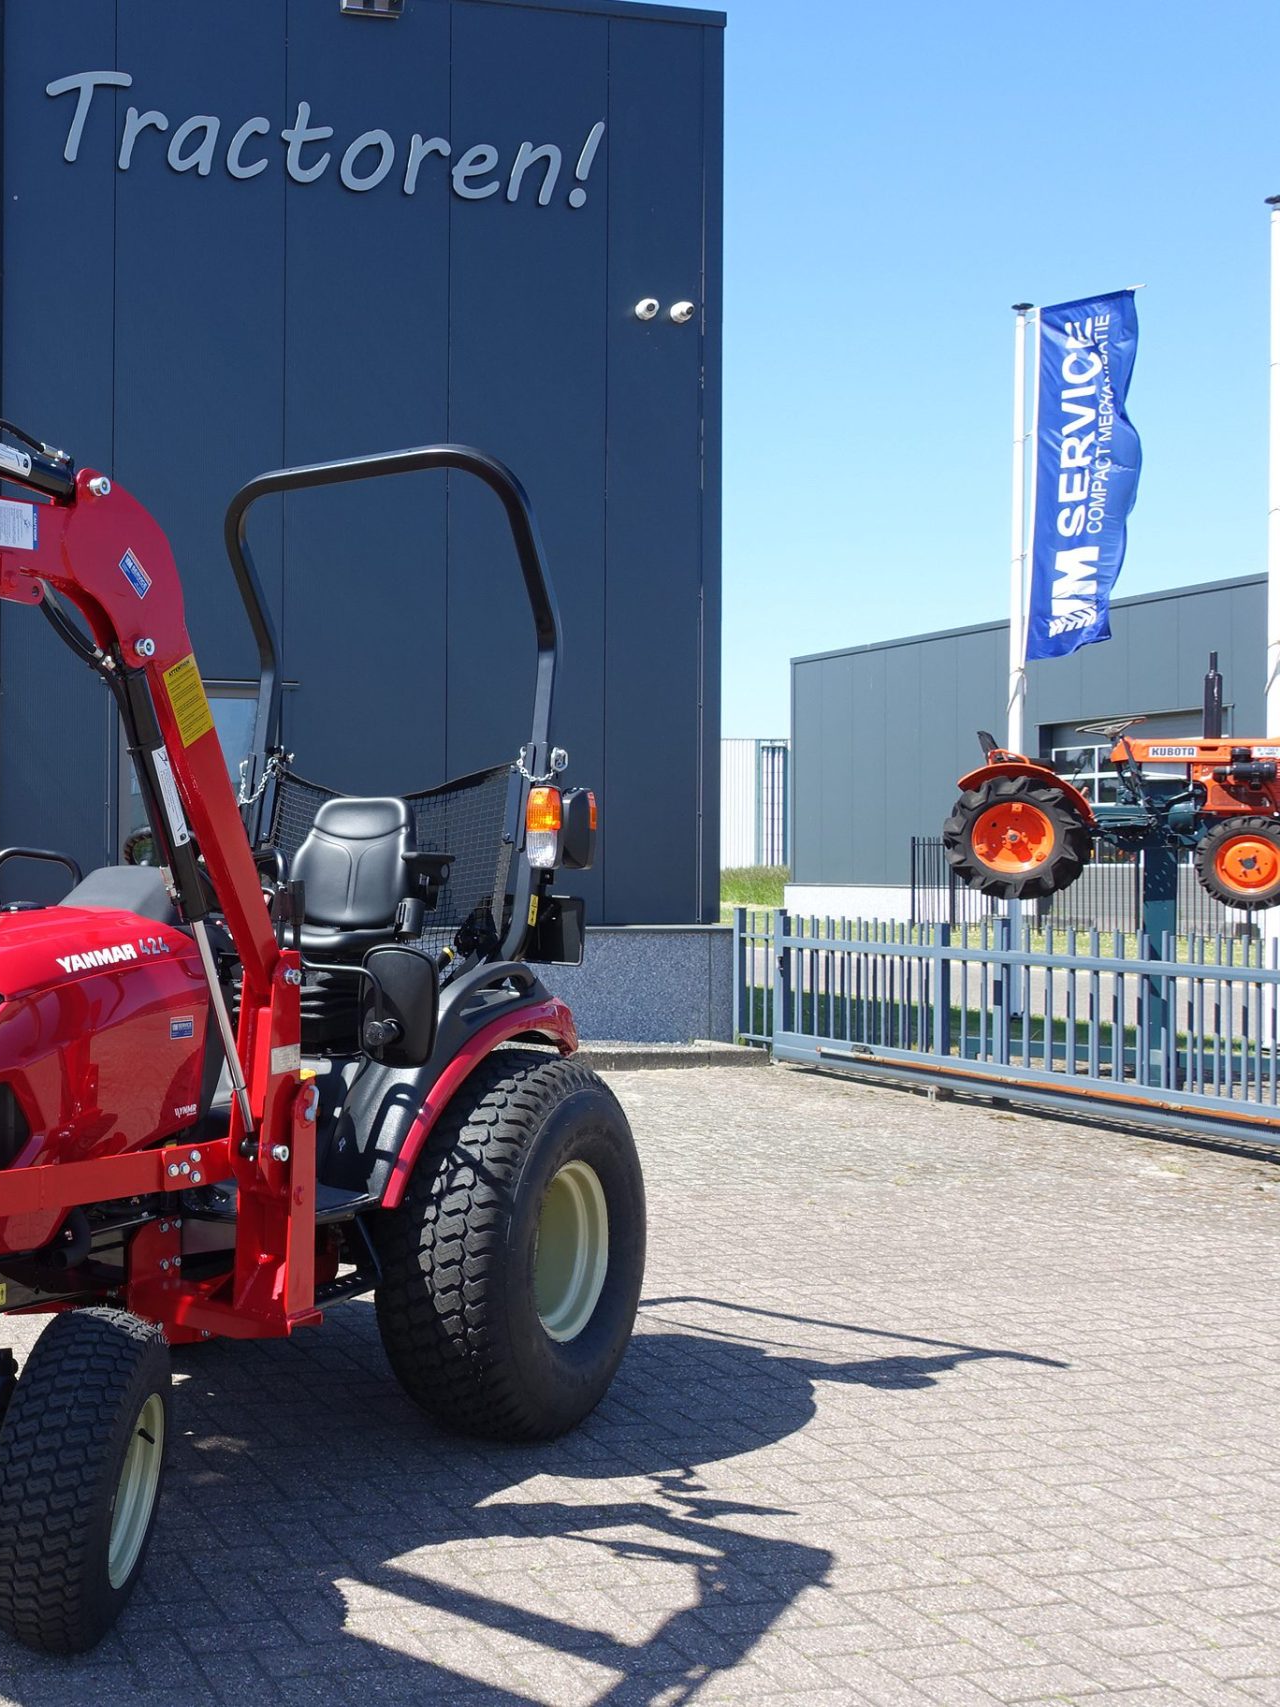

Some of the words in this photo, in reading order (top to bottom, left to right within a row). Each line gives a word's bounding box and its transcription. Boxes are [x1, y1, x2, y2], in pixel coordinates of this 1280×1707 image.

[46, 71, 606, 208] Tractoren!
[1057, 317, 1102, 537] SERVICE
[1086, 447, 1111, 534] COMPACT
[1151, 747, 1195, 756] KUBOTA
[56, 943, 138, 973] YANMAR
[138, 936, 170, 955] 424
